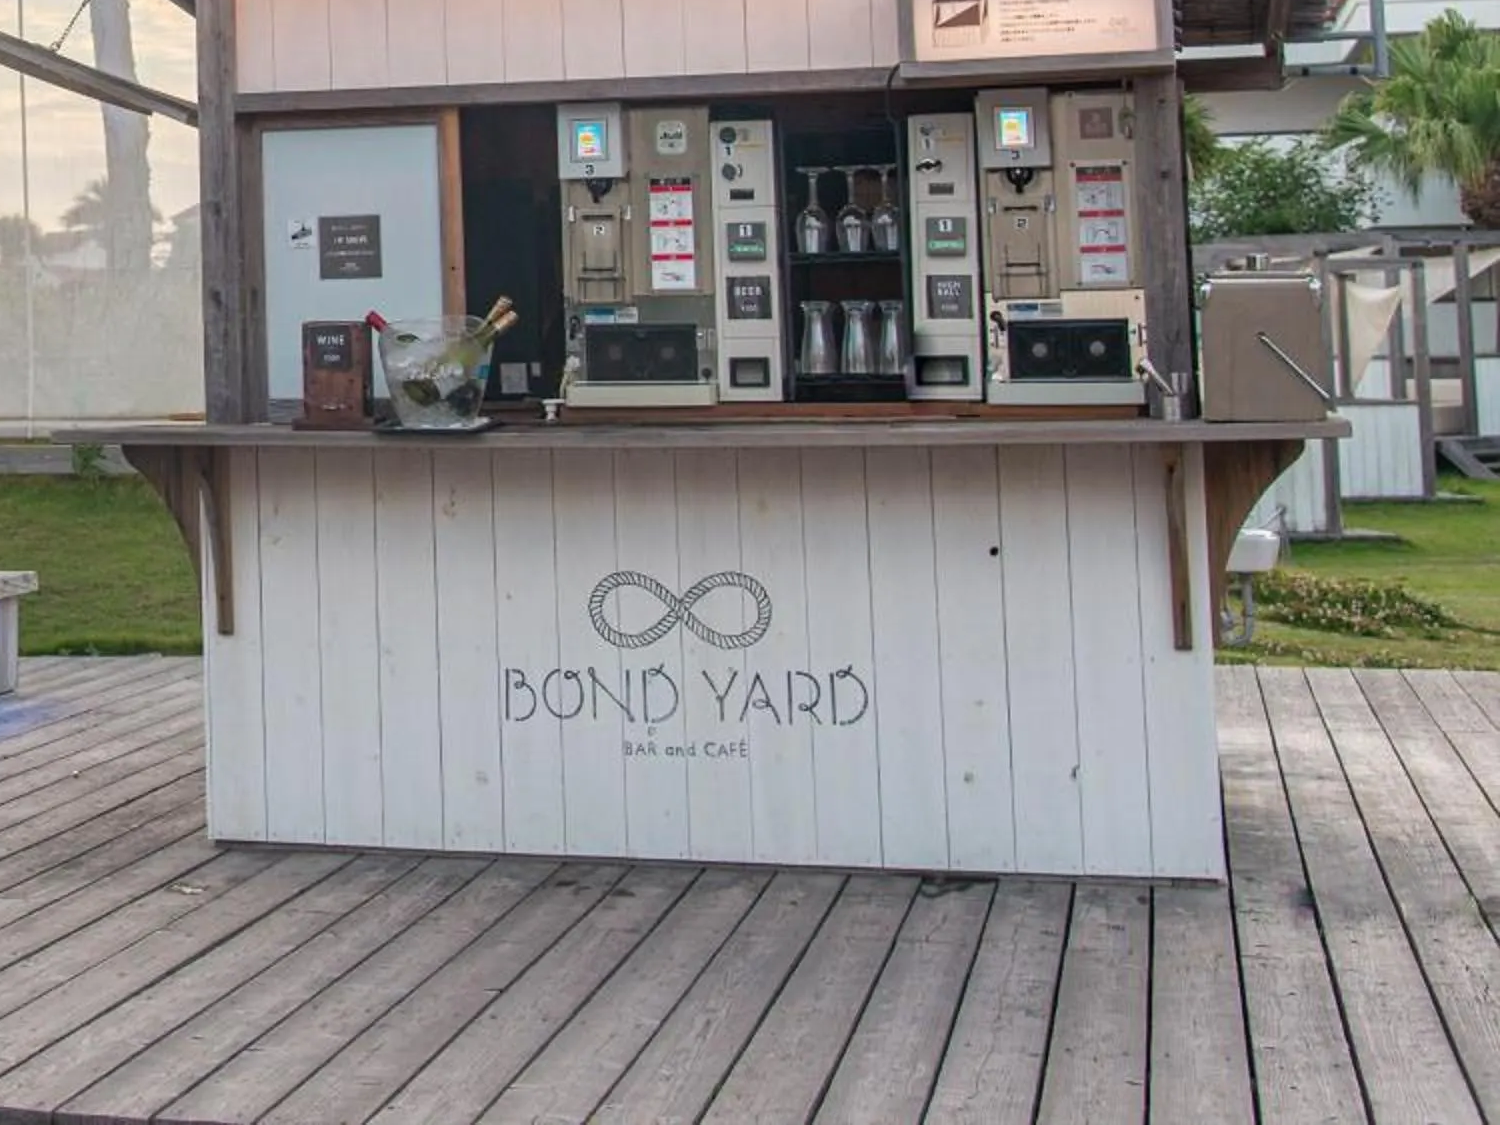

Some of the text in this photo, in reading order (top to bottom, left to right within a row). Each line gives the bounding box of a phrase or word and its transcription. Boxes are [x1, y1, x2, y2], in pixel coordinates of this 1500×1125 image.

[585, 164, 595, 175] 3
[734, 286, 762, 296] BEER
[316, 334, 345, 346] WINE
[504, 663, 870, 727] BOND YARD
[623, 740, 657, 756] BAR
[665, 741, 697, 757] and
